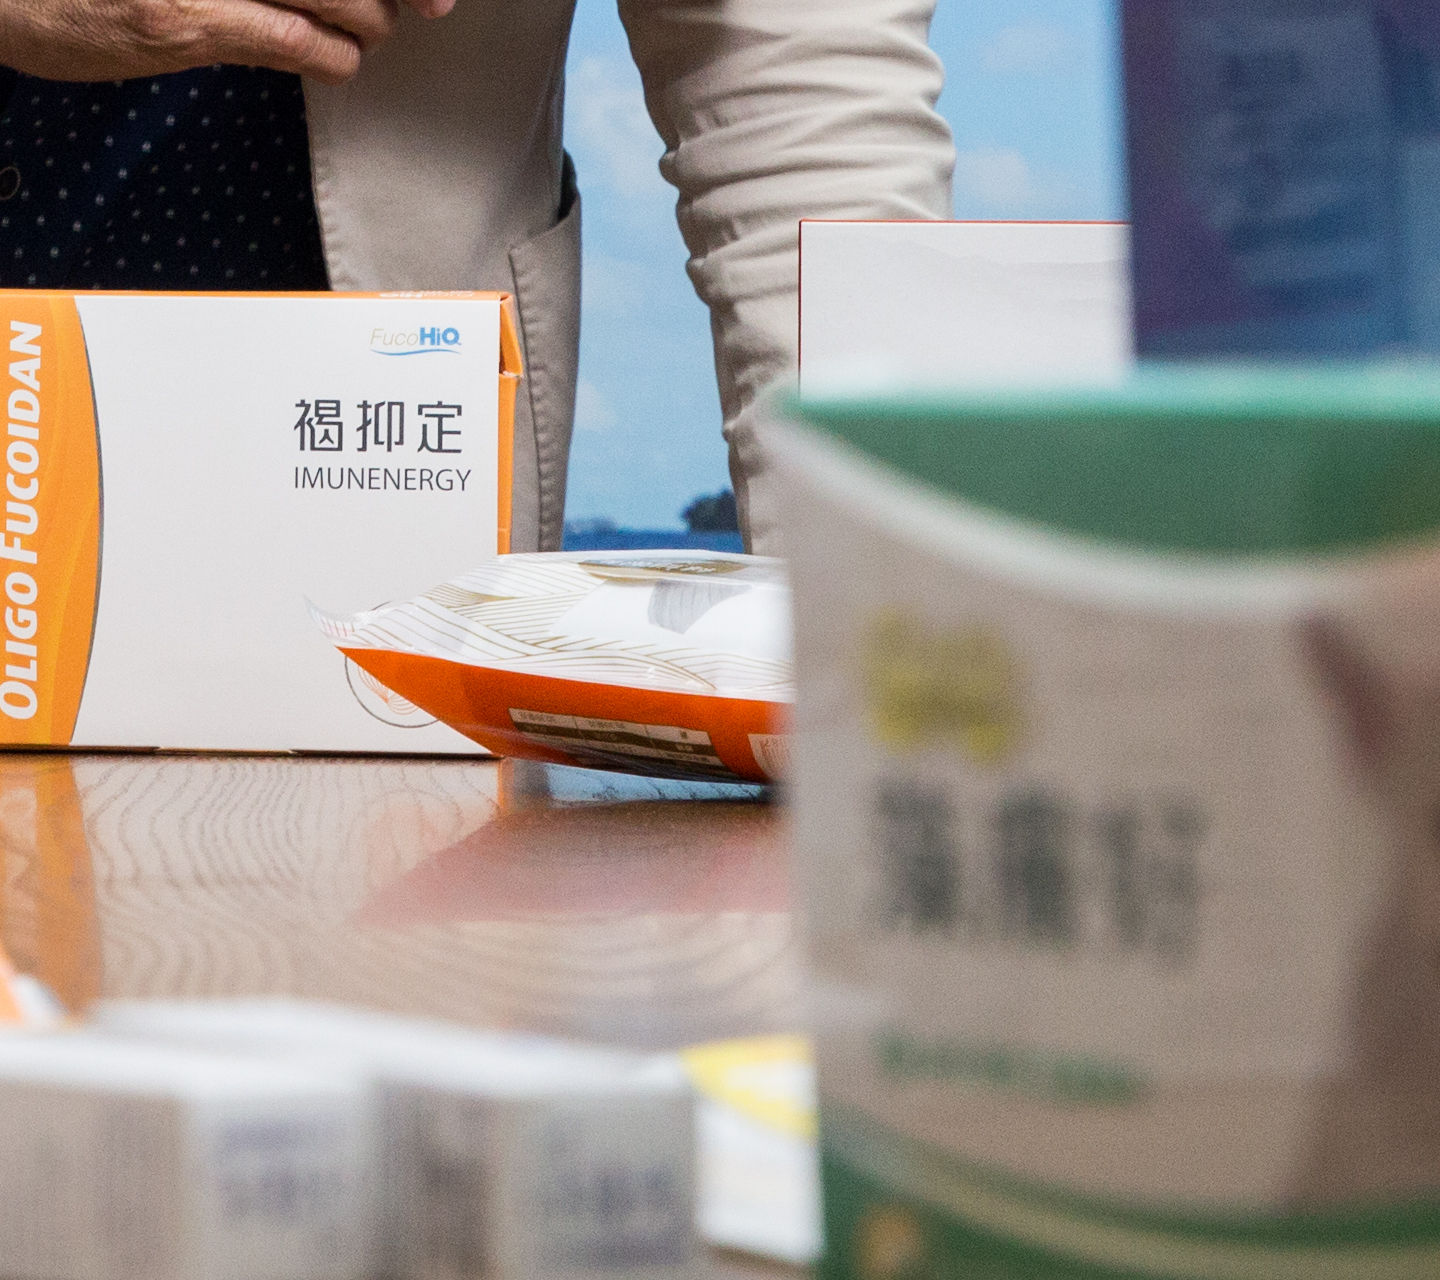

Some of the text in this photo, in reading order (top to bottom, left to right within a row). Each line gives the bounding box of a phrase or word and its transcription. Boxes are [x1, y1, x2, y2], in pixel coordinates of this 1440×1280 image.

[370, 326, 462, 347] FucoHiQ
[293, 398, 463, 454] 褐抑定
[294, 466, 472, 492] IMUNENERGY
